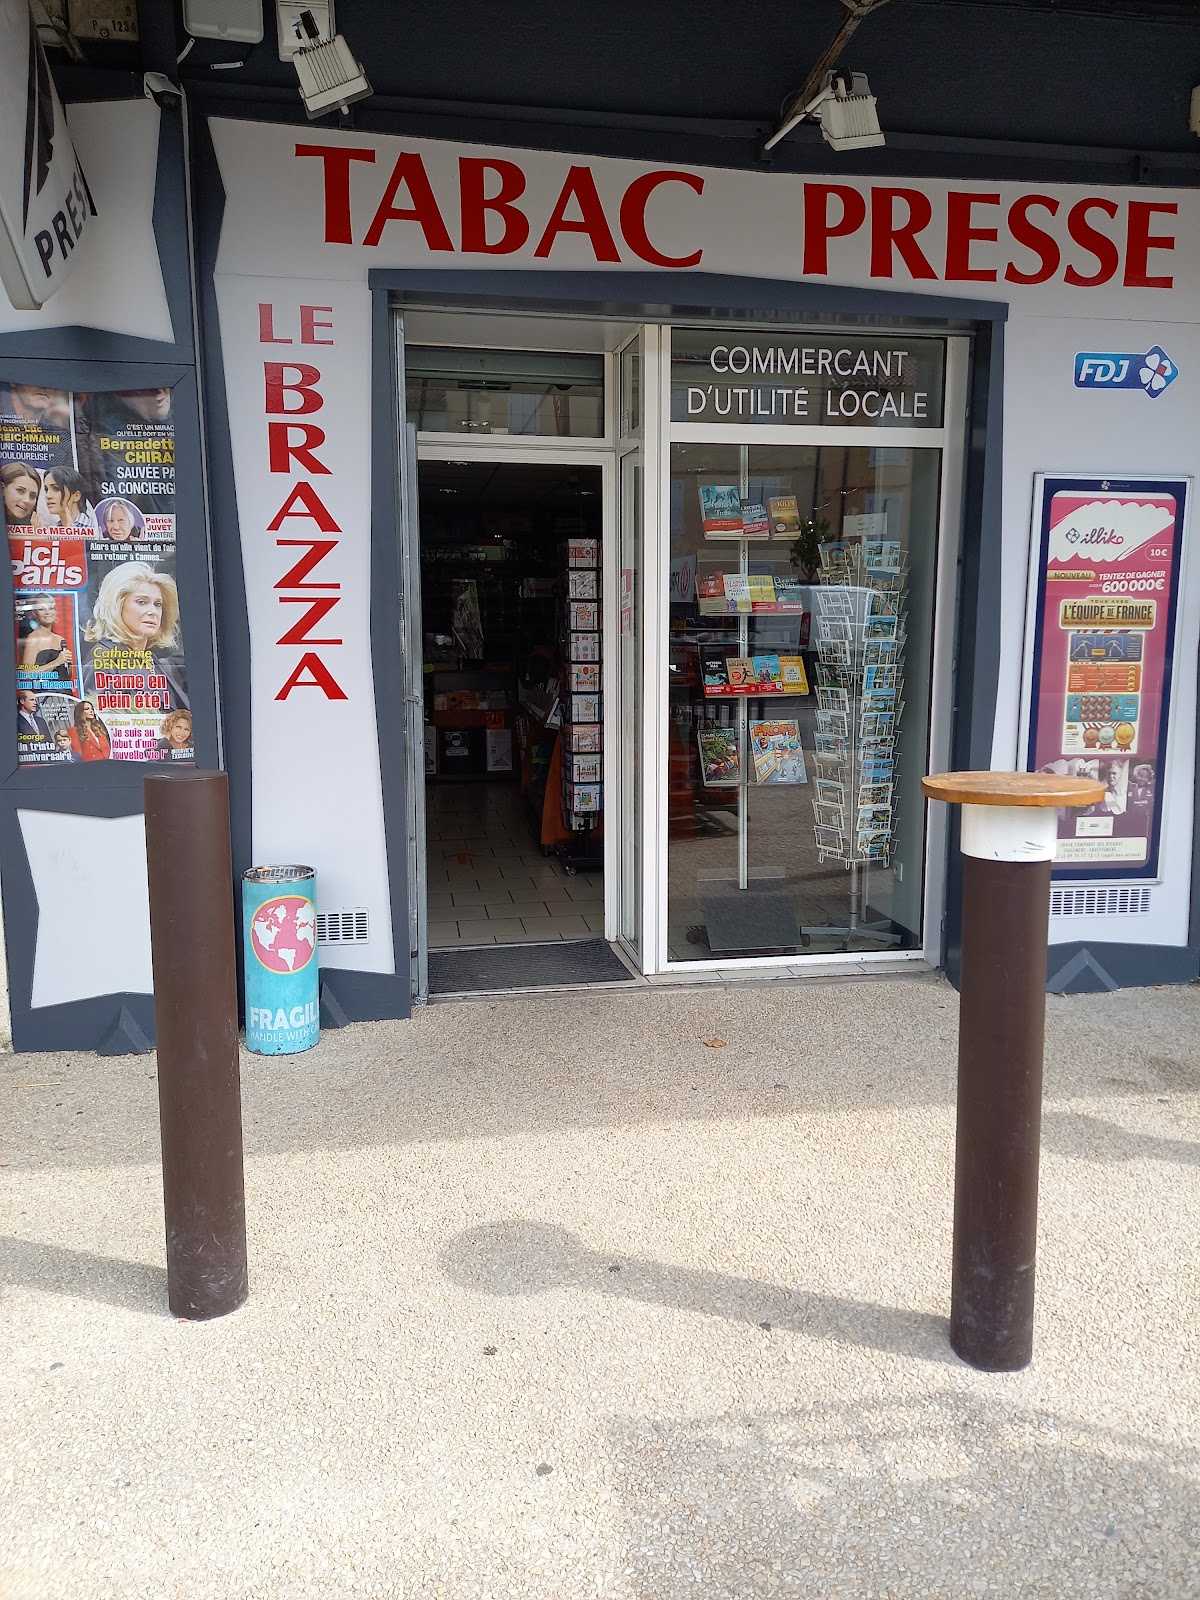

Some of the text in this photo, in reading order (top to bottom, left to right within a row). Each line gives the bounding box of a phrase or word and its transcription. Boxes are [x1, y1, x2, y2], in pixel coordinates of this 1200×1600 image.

[295, 143, 1179, 289] TABAC PRESSE
[34, 170, 88, 279] PRES
[258, 302, 334, 346] LE
[1078, 358, 1130, 383] FDJ
[687, 385, 928, 418] D'UTILITÉ LOCALE
[126, 423, 144, 431] C'EST
[0, 433, 60, 444] REICHMANN
[17, 442, 49, 452] DÉCISION
[124, 451, 175, 464] CHIRA
[116, 463, 176, 479] SAUVÉE PA
[101, 481, 176, 495] SA CONCIERG
[8, 525, 95, 536] KATE et MEGHAN
[264, 361, 350, 701] BRAZZA
[1080, 526, 1125, 545] illiko
[23, 540, 60, 566] ici
[90, 542, 109, 551] Alors
[110, 542, 133, 553] qu'elle
[133, 543, 152, 552] vient
[153, 544, 162, 552] de
[90, 553, 103, 561] son
[104, 552, 128, 561] retour
[11, 559, 83, 585] Paris
[1053, 572, 1092, 580] NOUVEAU
[1098, 570, 1166, 581] TENTEZ DE GAGNER
[1063, 601, 1153, 621] L'ÉQUIPE DE FRANCE
[93, 646, 153, 658] Catherine
[93, 658, 153, 670] DENEUVE
[95, 671, 167, 690] Drame en
[97, 690, 131, 711] plein
[134, 690, 161, 710] été
[17, 733, 45, 741] George
[124, 728, 142, 738] suis
[144, 729, 155, 738] au
[753, 724, 797, 737] PROFS
[30, 741, 56, 752] triste
[134, 738, 158, 749] d'une
[18, 751, 72, 762] anniversaire
[145, 749, 160, 760] vie
[250, 1030, 284, 1043] HANDLE
[286, 1027, 309, 1041] WITH
